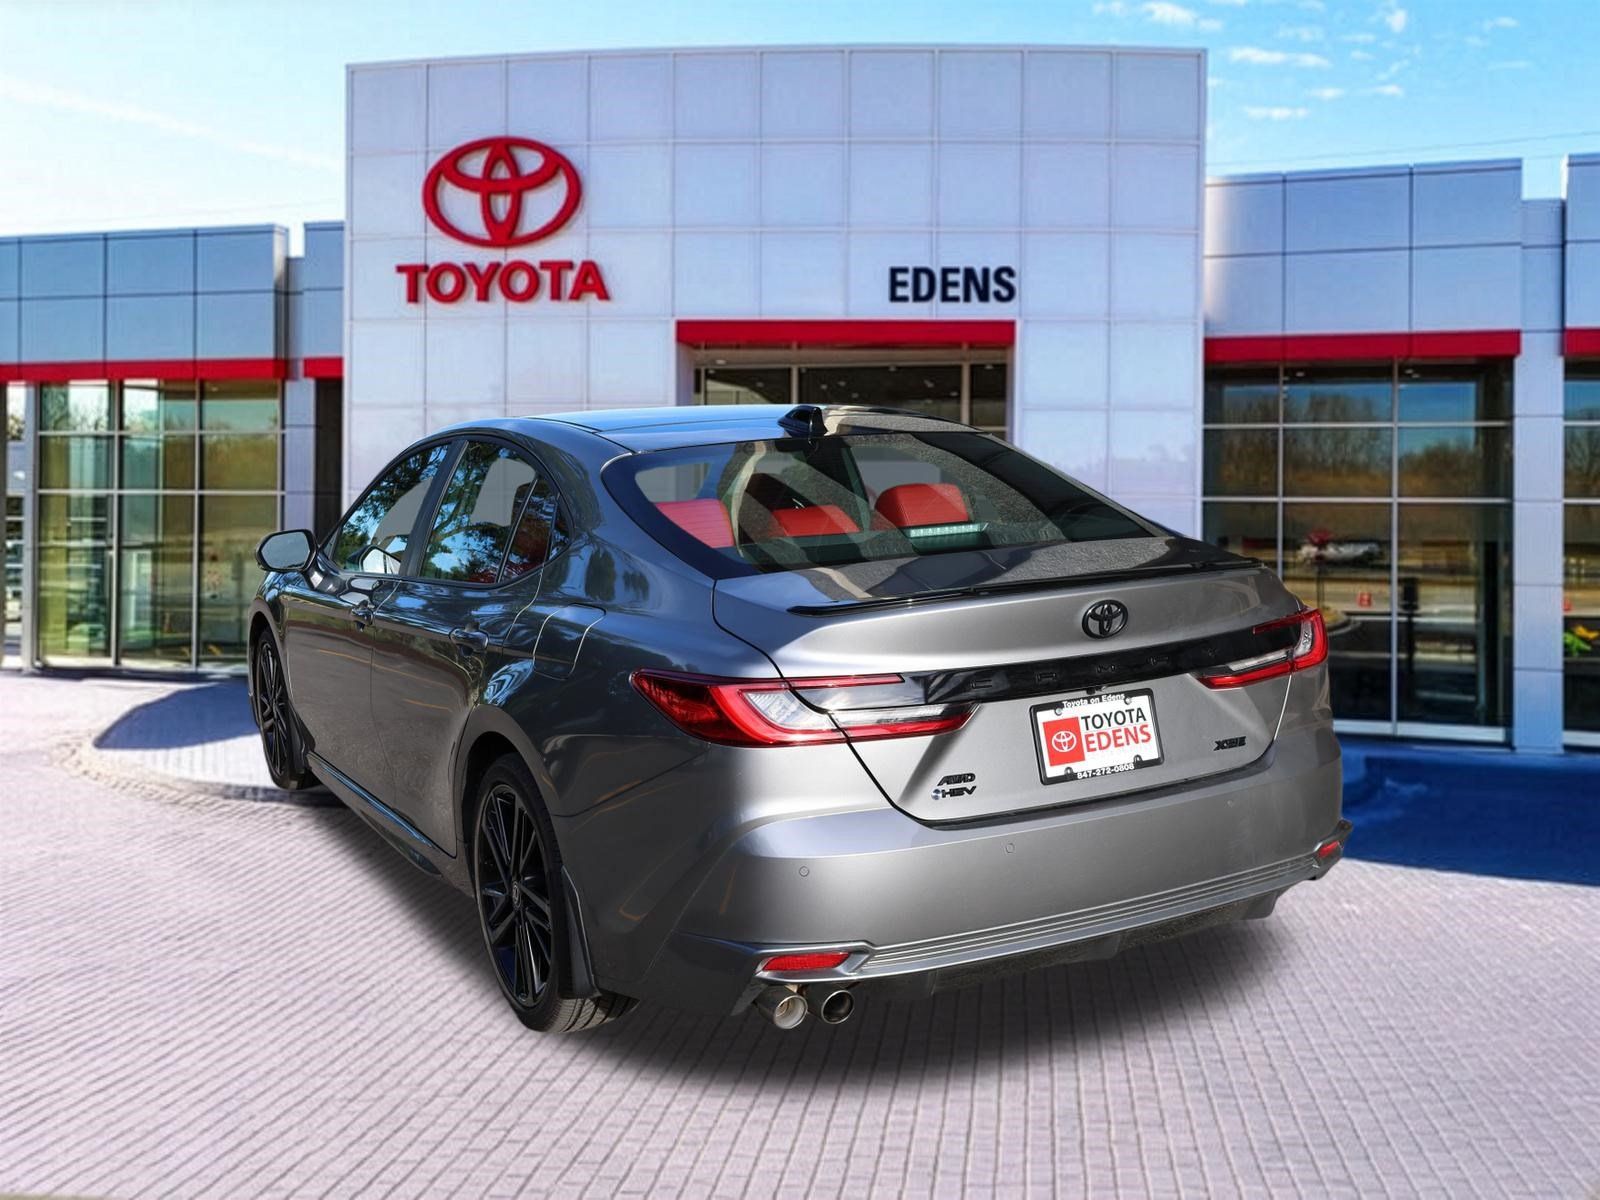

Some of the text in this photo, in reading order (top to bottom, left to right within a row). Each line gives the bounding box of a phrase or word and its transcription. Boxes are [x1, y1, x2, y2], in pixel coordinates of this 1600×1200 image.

[395, 260, 611, 304] TOYOTA
[889, 266, 1016, 303] EDENS
[1062, 693, 1125, 709] Toyota on Edens
[1081, 707, 1147, 730] TOYOTA
[1084, 724, 1151, 752] EDENS
